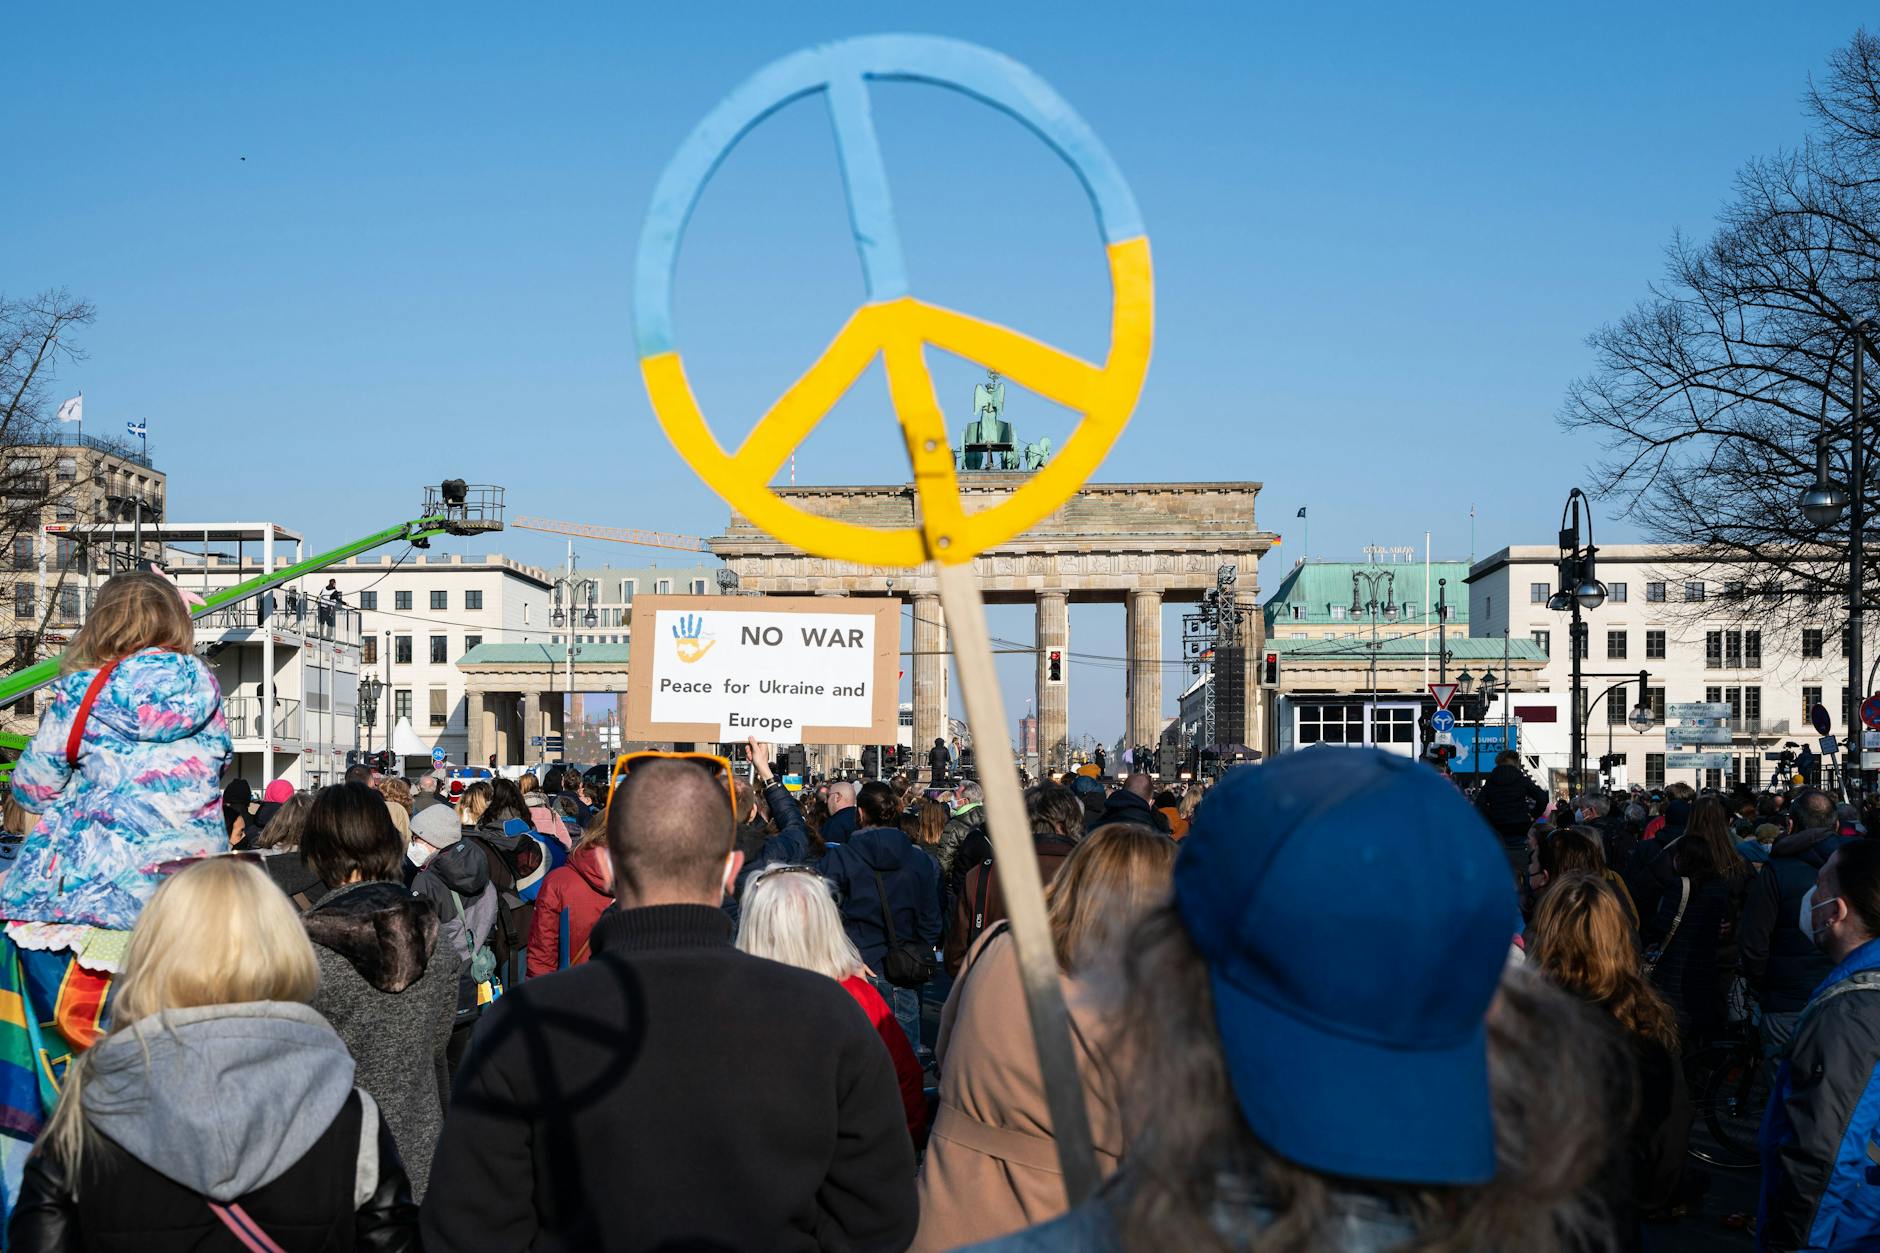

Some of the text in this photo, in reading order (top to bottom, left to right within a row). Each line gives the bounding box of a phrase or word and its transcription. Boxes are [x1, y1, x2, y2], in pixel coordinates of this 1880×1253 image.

[741, 626, 864, 649] NO WAR
[660, 678, 865, 697] Peace for Ukraine and
[728, 713, 793, 732] Europe
